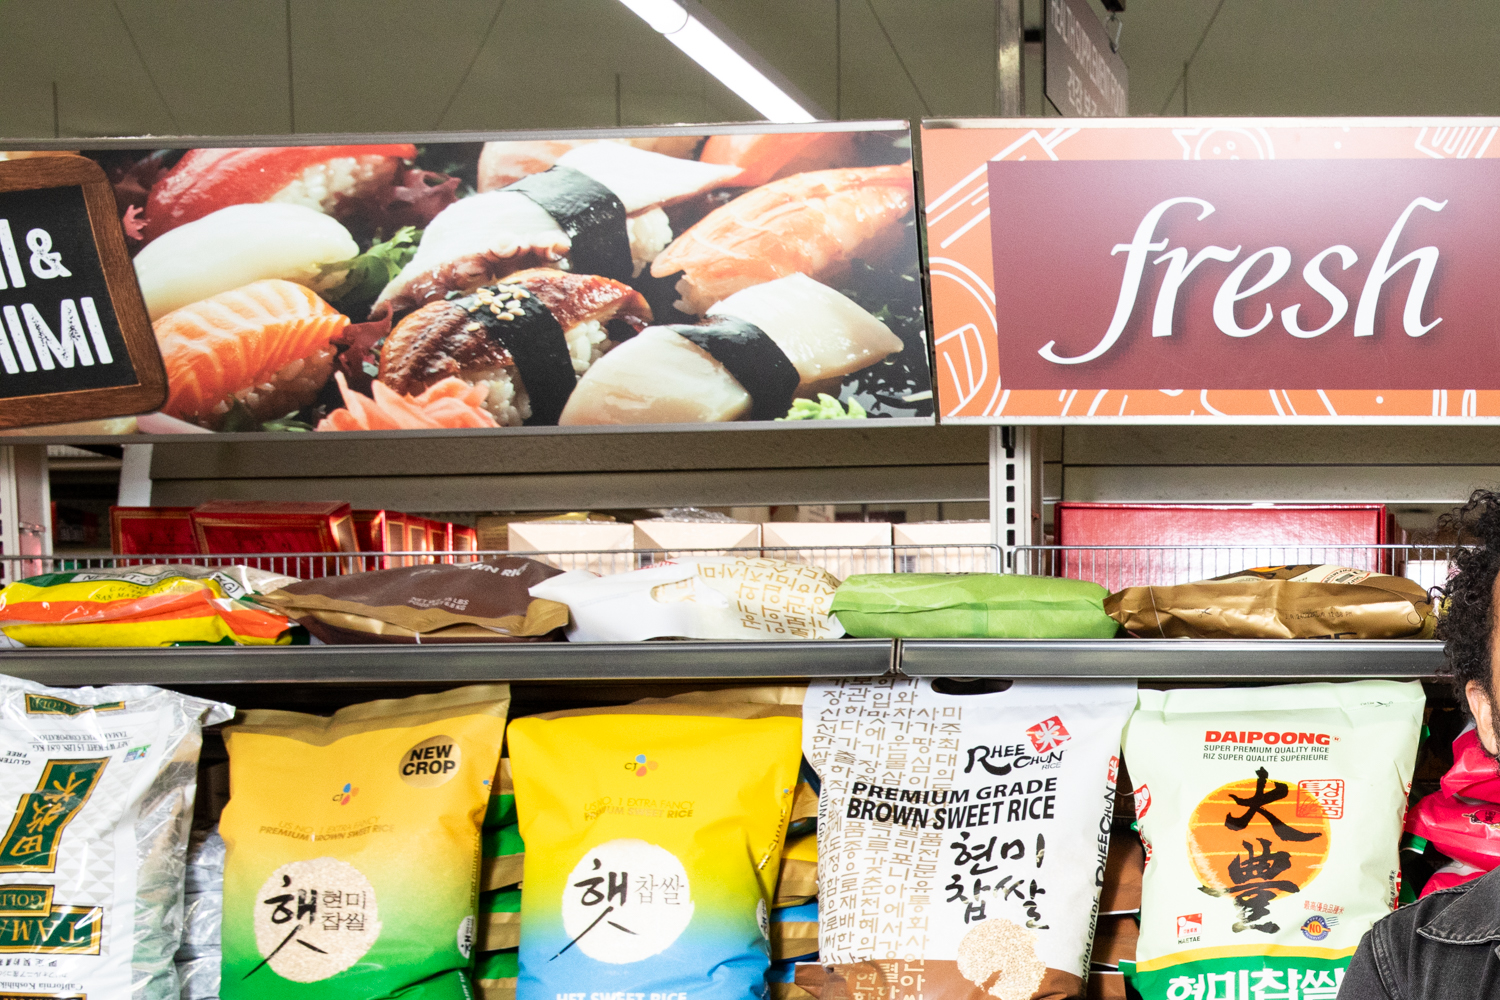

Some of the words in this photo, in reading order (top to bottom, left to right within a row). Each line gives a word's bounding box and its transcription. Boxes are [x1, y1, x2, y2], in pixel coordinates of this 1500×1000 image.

[26, 228, 72, 279] &
[1037, 196, 1448, 366] fresh
[409, 744, 453, 762] NEW
[1204, 730, 1330, 745] DAIPOONG
[402, 760, 456, 776] CROP
[964, 744, 1025, 775] RHEE
[1013, 749, 1064, 770] CHUN
[852, 781, 971, 806] PREMIUM
[977, 776, 1058, 800] GRADE
[846, 799, 928, 829] BROWN
[932, 800, 1005, 831] SWEET
[1008, 795, 1056, 821] RICE
[950, 831, 1046, 876] 현미
